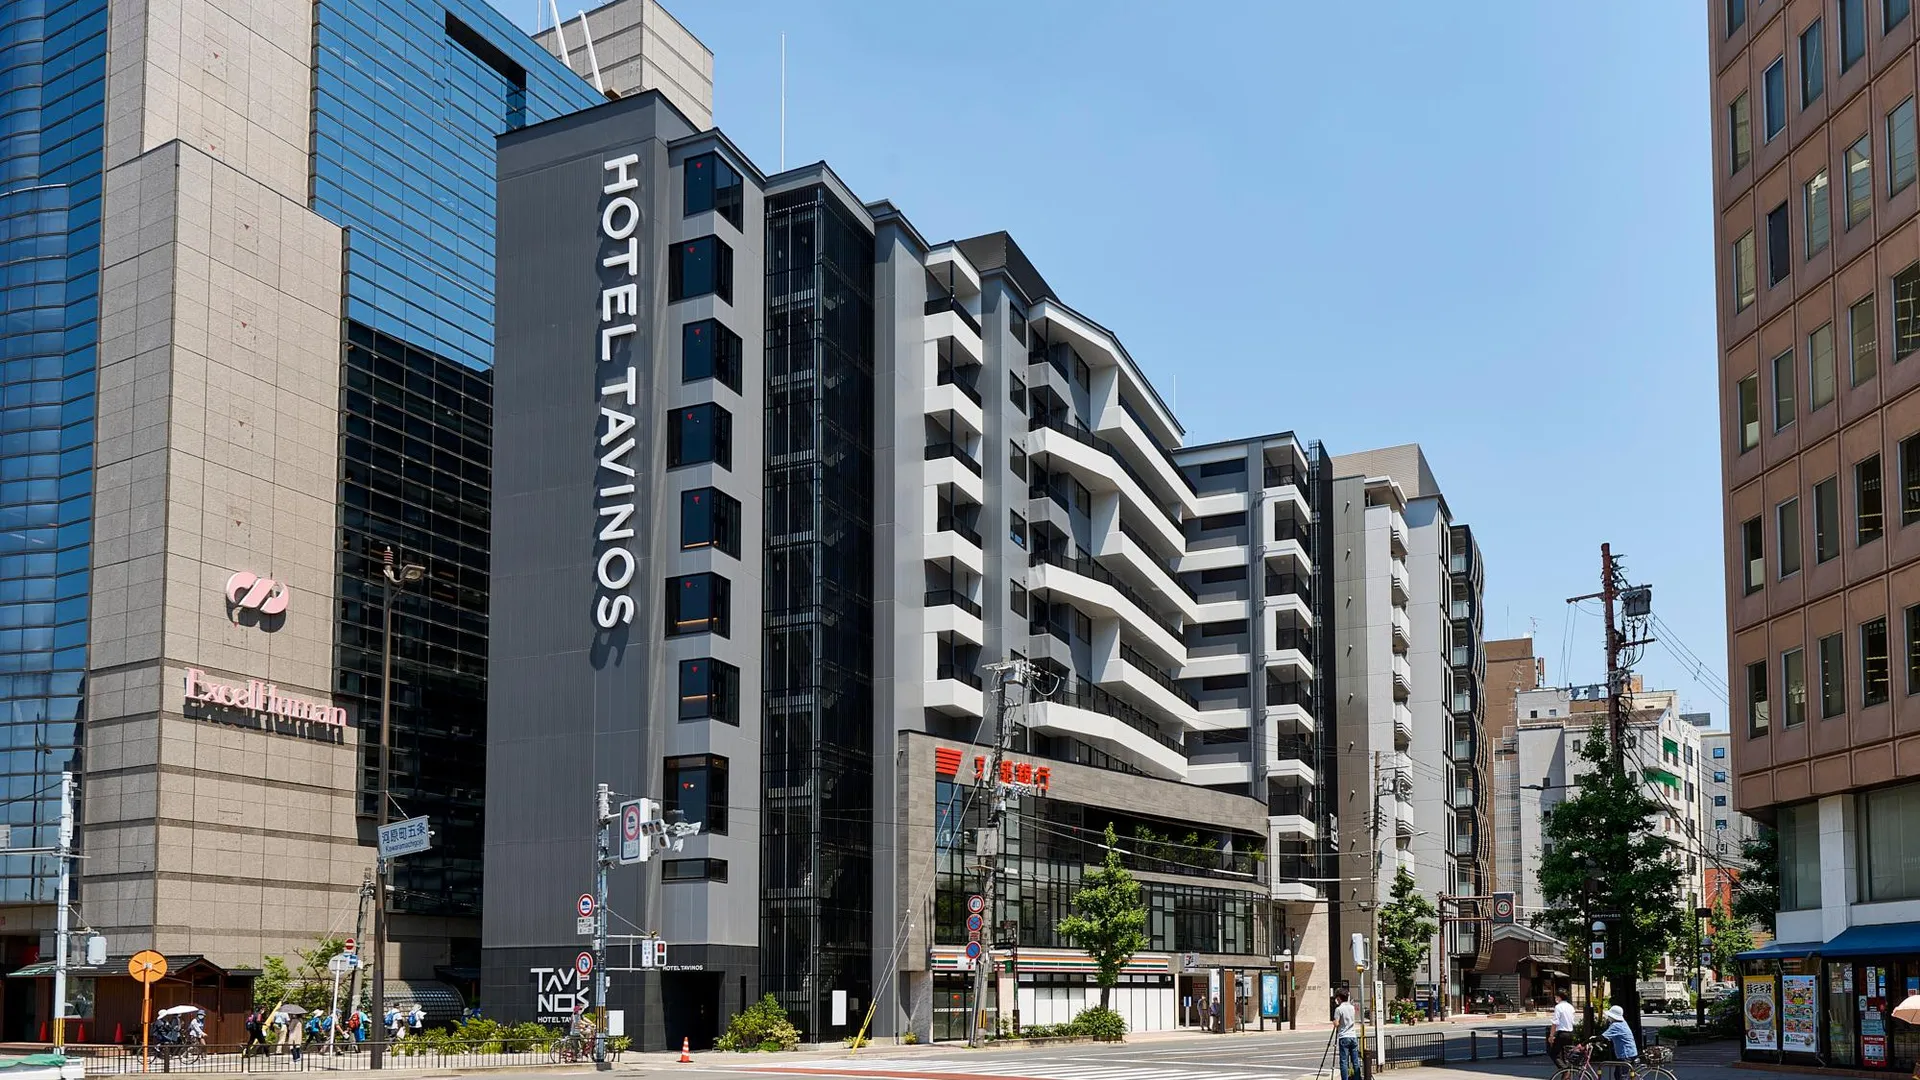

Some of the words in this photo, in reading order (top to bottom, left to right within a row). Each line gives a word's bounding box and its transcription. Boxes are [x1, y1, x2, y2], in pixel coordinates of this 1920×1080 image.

[601, 153, 640, 362] HOTEL
[597, 366, 636, 629] TAVINOS
[381, 822, 426, 844] 河原町五条
[971, 900, 981, 909] 40
[1499, 903, 1508, 912] 40
[537, 986, 589, 1014] NOS
[537, 1016, 560, 1024] HOTEL
